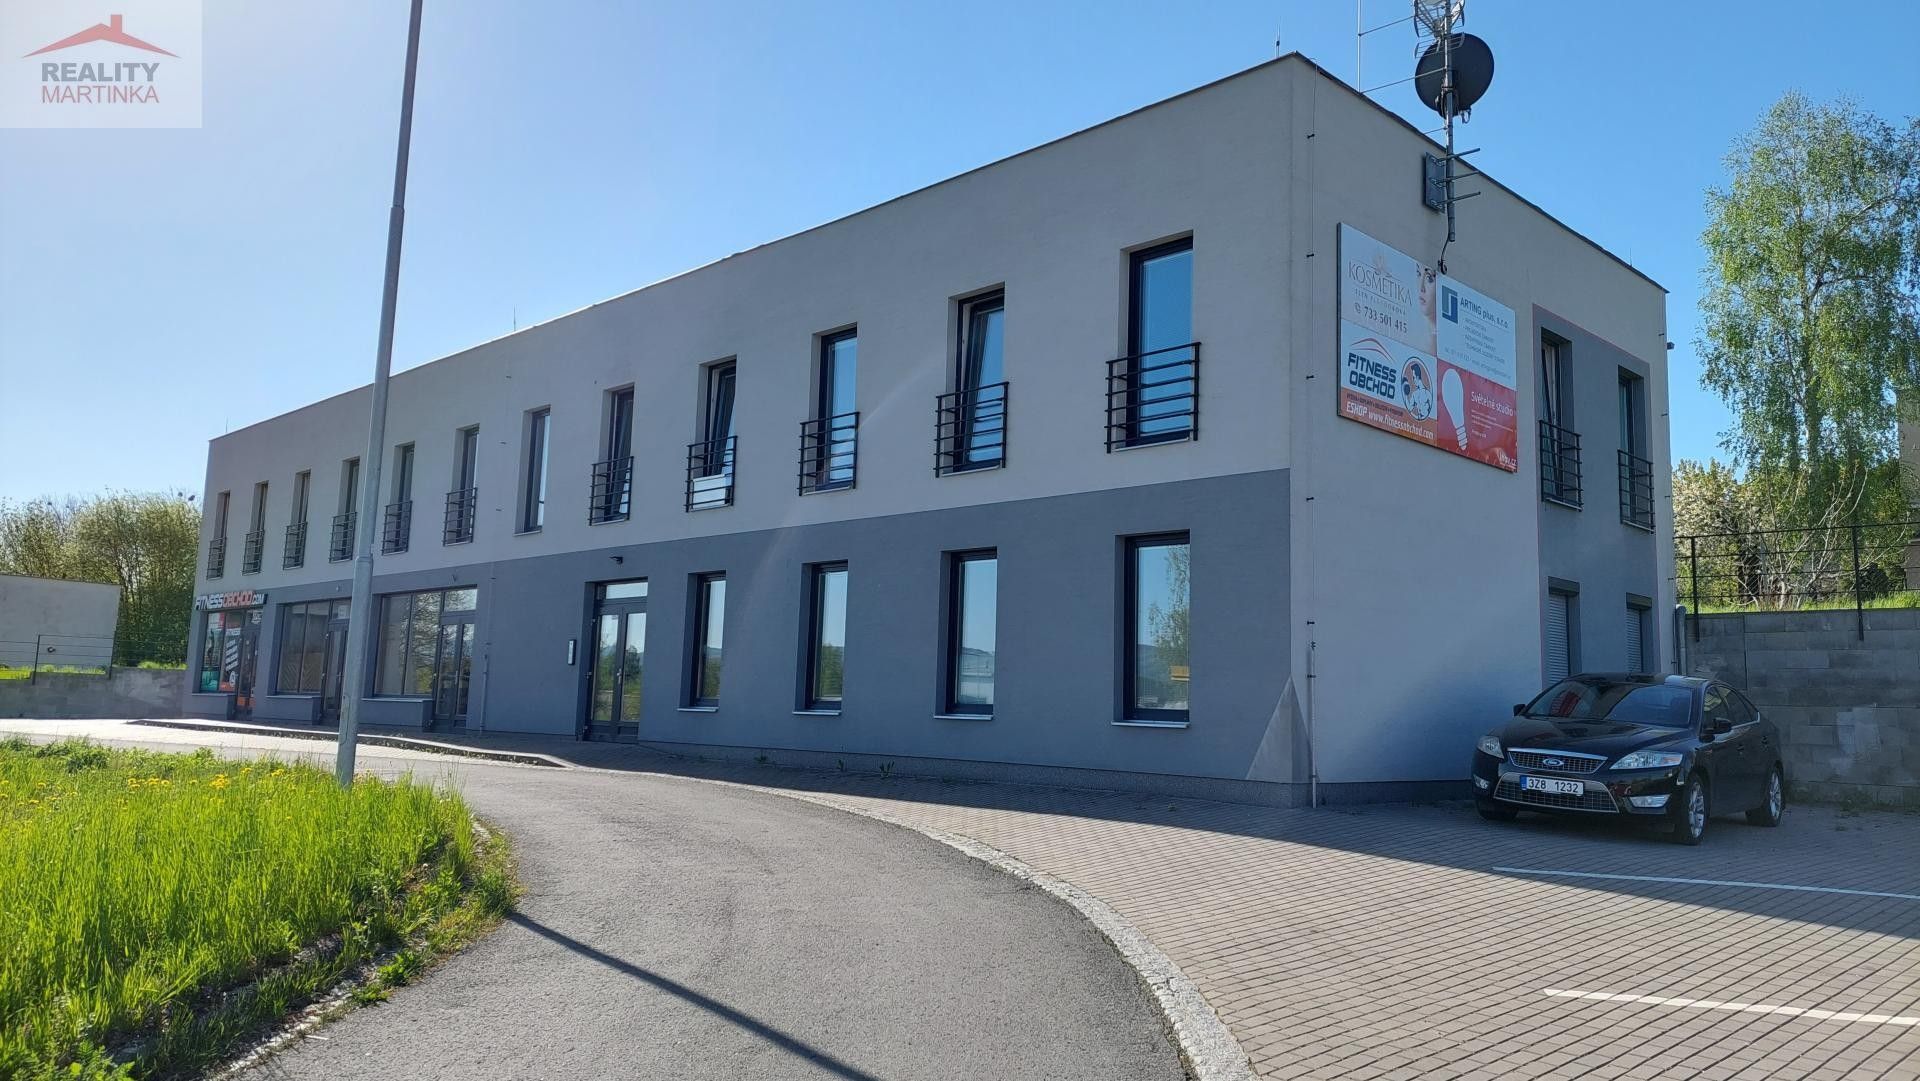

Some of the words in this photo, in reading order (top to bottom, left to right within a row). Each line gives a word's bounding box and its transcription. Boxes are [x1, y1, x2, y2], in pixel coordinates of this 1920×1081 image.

[1348, 261, 1412, 305] KOSMETIKA
[1364, 306, 1378, 321] 733
[1379, 313, 1393, 328] 501
[1460, 297, 1482, 315] ARTING
[1347, 352, 1397, 384] FITNESS
[1349, 370, 1396, 400] OBCHOD
[1346, 401, 1368, 417] ESHOP
[1528, 778, 1547, 790] 3Z8
[1555, 781, 1579, 793] 1232
